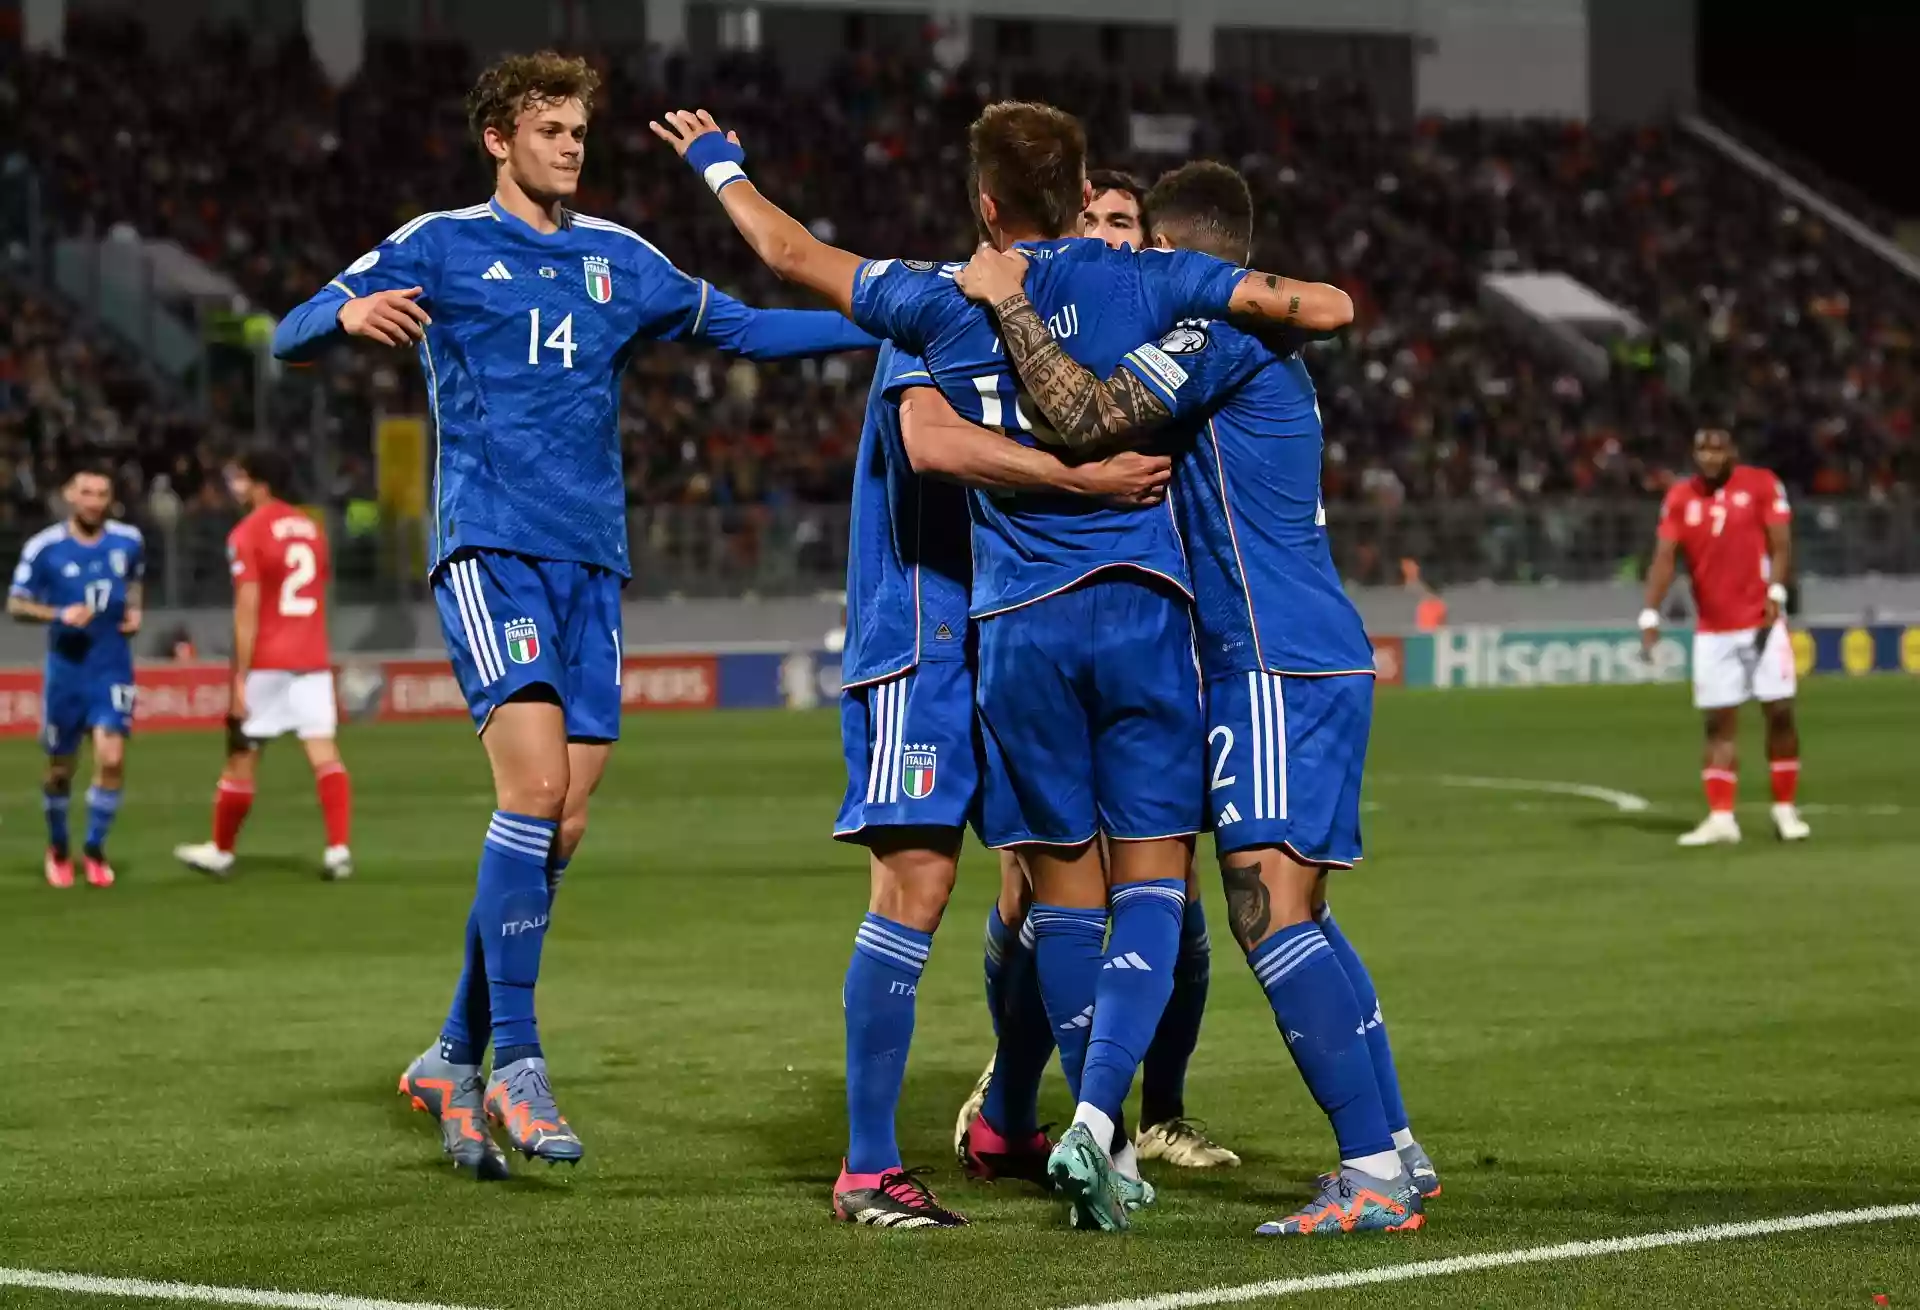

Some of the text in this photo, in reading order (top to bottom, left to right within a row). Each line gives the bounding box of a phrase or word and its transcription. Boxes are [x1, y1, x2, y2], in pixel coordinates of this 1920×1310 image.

[528, 308, 578, 368] 14
[1042, 303, 1078, 340] GUI
[1708, 504, 1727, 537] 7
[84, 578, 113, 613] 17
[278, 542, 318, 617] 2
[508, 627, 534, 639] ITALIA
[1434, 624, 1687, 689] Hisense
[906, 755, 933, 766] ITALIA
[1207, 725, 1236, 791] 2
